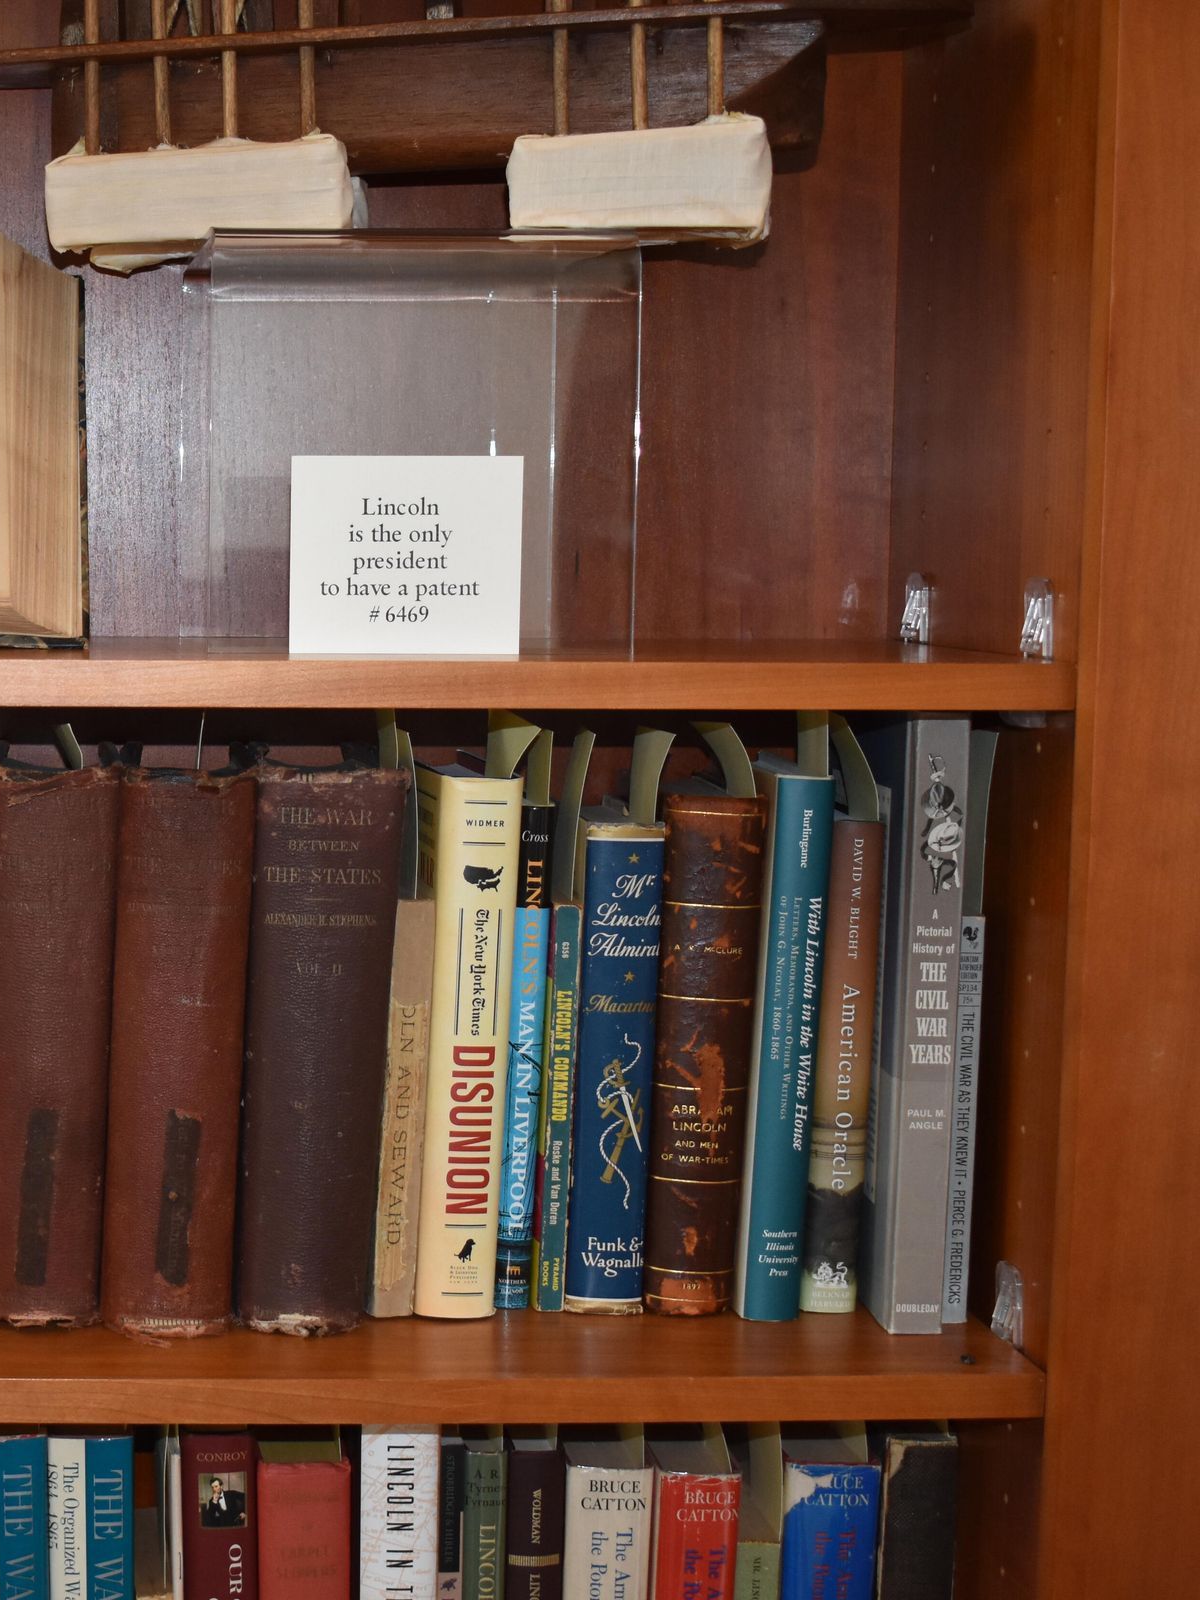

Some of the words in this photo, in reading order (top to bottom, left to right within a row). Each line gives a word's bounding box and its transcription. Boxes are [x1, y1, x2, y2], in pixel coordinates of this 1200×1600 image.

[361, 496, 440, 516] Lincoln
[348, 524, 363, 543] is
[371, 523, 402, 543] the
[409, 523, 453, 548] only
[352, 550, 448, 575] president
[320, 580, 340, 596] to
[346, 577, 391, 596] have
[398, 583, 409, 596] a
[415, 580, 480, 602] patent
[368, 605, 380, 623] #
[385, 605, 429, 623] 6469
[465, 818, 506, 828] WIDMER
[287, 839, 360, 852] BETWEEN
[521, 829, 549, 844] Cross
[799, 808, 815, 869] Burlingame
[852, 837, 865, 883] DAVID
[263, 865, 300, 884] THE
[310, 867, 382, 886] STATES
[611, 873, 658, 899] Mr.
[850, 886, 862, 903] W.
[520, 858, 544, 996] LINCOLN'S
[847, 906, 862, 960] BLIGHT
[916, 925, 953, 938] Pictorial
[919, 962, 947, 982] THE
[915, 989, 949, 1010] CIVIL
[517, 1000, 536, 1056] MAN
[554, 990, 574, 1052] LINCOLN'S
[915, 1017, 948, 1037] WAR
[836, 983, 861, 1102] American
[908, 1044, 952, 1065] YEARS
[514, 1062, 532, 1090] IN
[551, 1055, 571, 1122] COMMANDO
[445, 1045, 496, 1216] DISUNION
[671, 1120, 728, 1133] LINCOLN
[909, 1120, 944, 1130] ANGLE
[831, 1111, 854, 1191] Oracle
[506, 1095, 533, 1236] LIVERPOOL
[761, 1229, 798, 1239] Southern
[580, 1252, 645, 1278] Wagnalls
[757, 1254, 799, 1265] University
[895, 1303, 940, 1314] DOUBLEDAY
[196, 1449, 248, 1464] CONROY
[62, 1462, 80, 1493] The
[386, 1444, 415, 1532] LINCOLN
[588, 1479, 642, 1495] BRUCE
[2, 1464, 34, 1538] THE
[93, 1468, 124, 1541] THE
[580, 1496, 648, 1512] CATTON
[684, 1490, 737, 1505] BRUCE
[803, 1492, 871, 1508] CATTON
[530, 1487, 543, 1546] WOLDMAN
[676, 1507, 740, 1523] CATTON
[61, 1497, 81, 1576] Organized
[614, 1527, 634, 1562] The
[228, 1543, 243, 1595] OUR
[385, 1549, 415, 1569] IN
